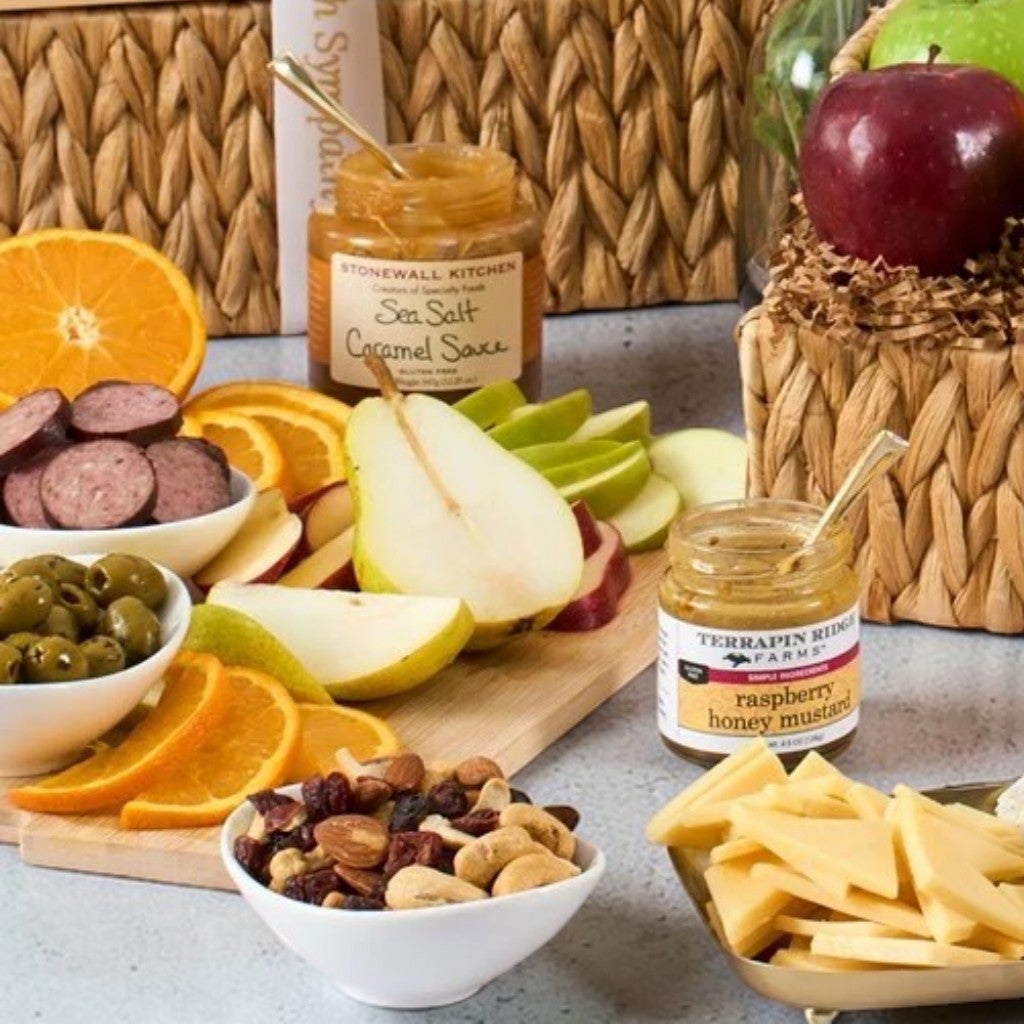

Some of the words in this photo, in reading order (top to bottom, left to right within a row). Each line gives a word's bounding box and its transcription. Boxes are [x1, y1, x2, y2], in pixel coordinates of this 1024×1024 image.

[341, 263, 443, 281] STONEWALL
[449, 263, 515, 279] KITCHEN
[375, 298, 423, 325] Sea
[425, 297, 479, 327] Salt
[345, 328, 433, 363] Caramel
[440, 334, 508, 363] Sauce
[697, 632, 806, 649] TERRAPIN
[812, 615, 855, 641] RIDGE
[755, 649, 820, 663] FARMS
[736, 681, 834, 711] raspberry
[708, 709, 772, 734] honey
[780, 689, 851, 728] mustard
